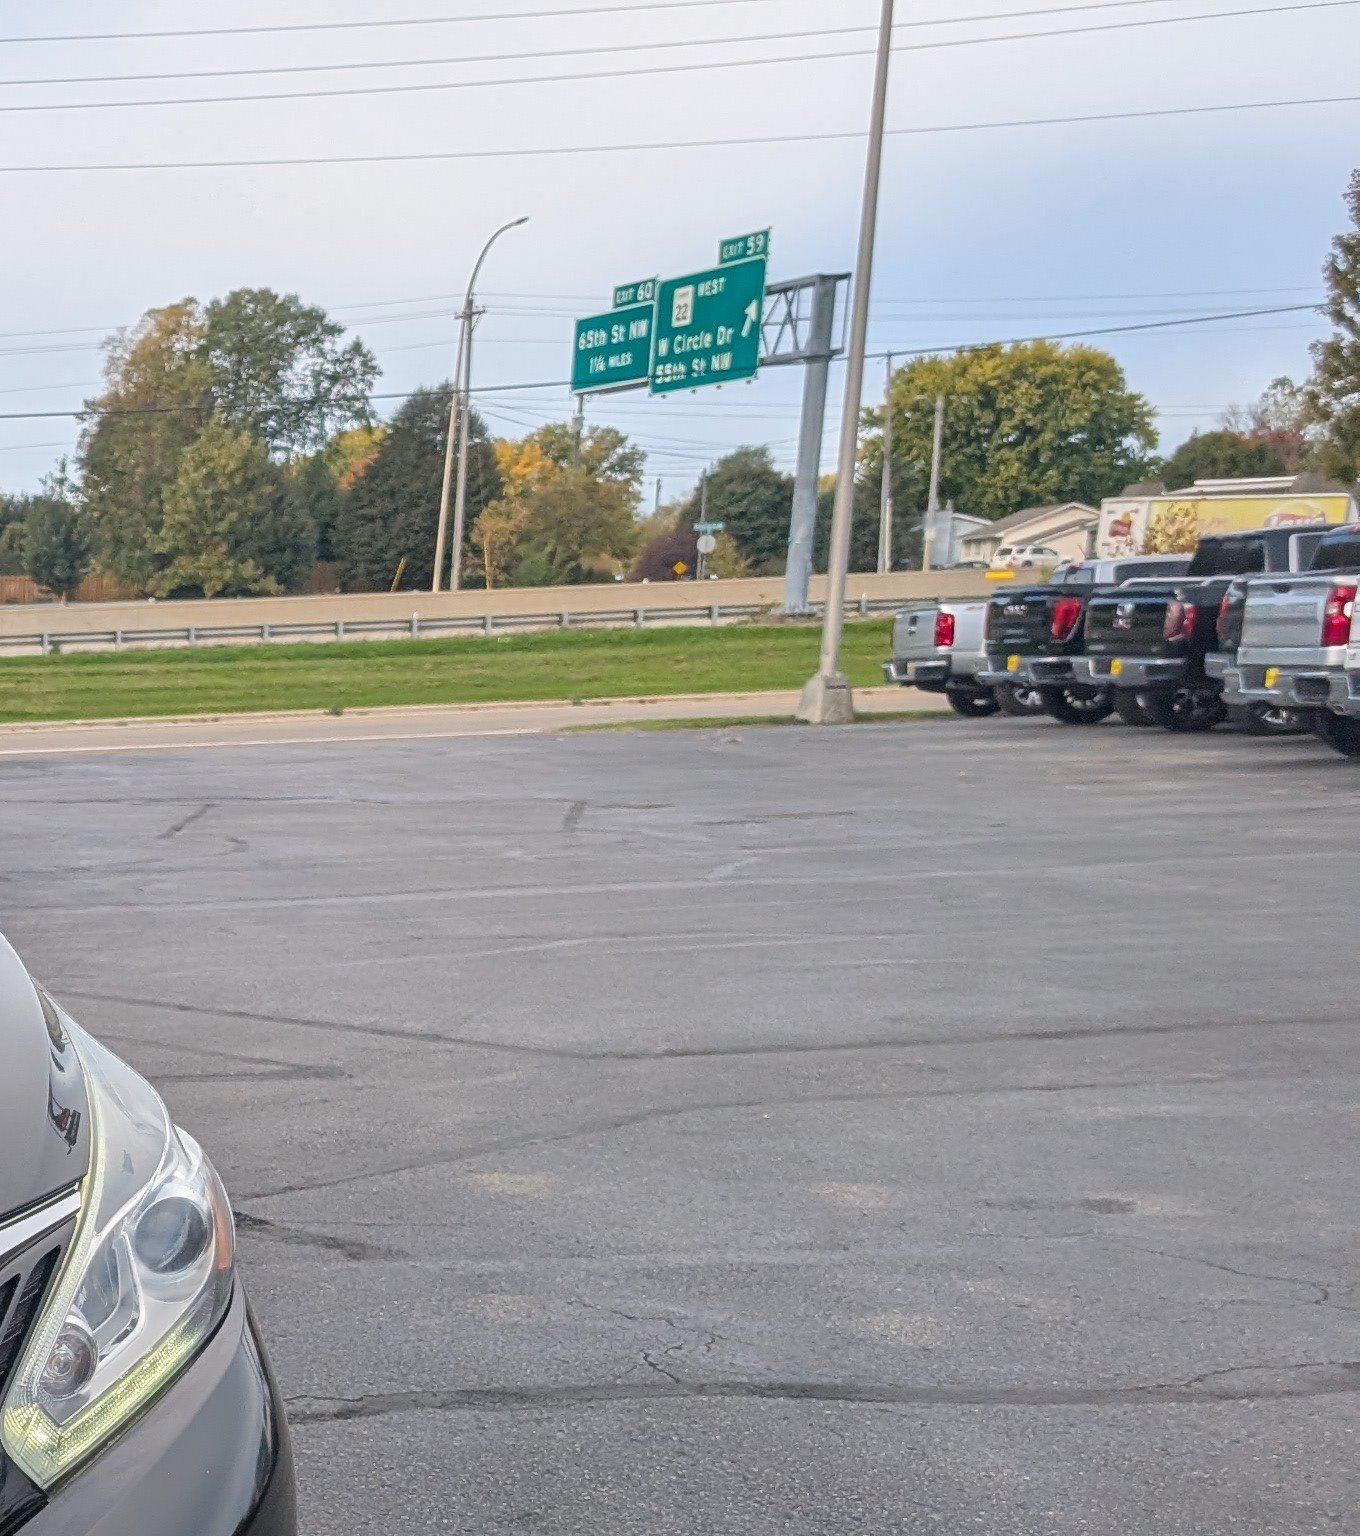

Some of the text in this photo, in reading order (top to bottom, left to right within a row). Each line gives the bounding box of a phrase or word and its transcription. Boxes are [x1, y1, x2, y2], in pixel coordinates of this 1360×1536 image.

[746, 234, 764, 256] 59
[637, 281, 653, 301] 60
[697, 277, 726, 297] WEST
[675, 303, 688, 321] 22
[578, 319, 649, 350] 65th St NW
[658, 325, 735, 357] W Circle Dr
[691, 357, 707, 377] St
[711, 352, 733, 371] NW
